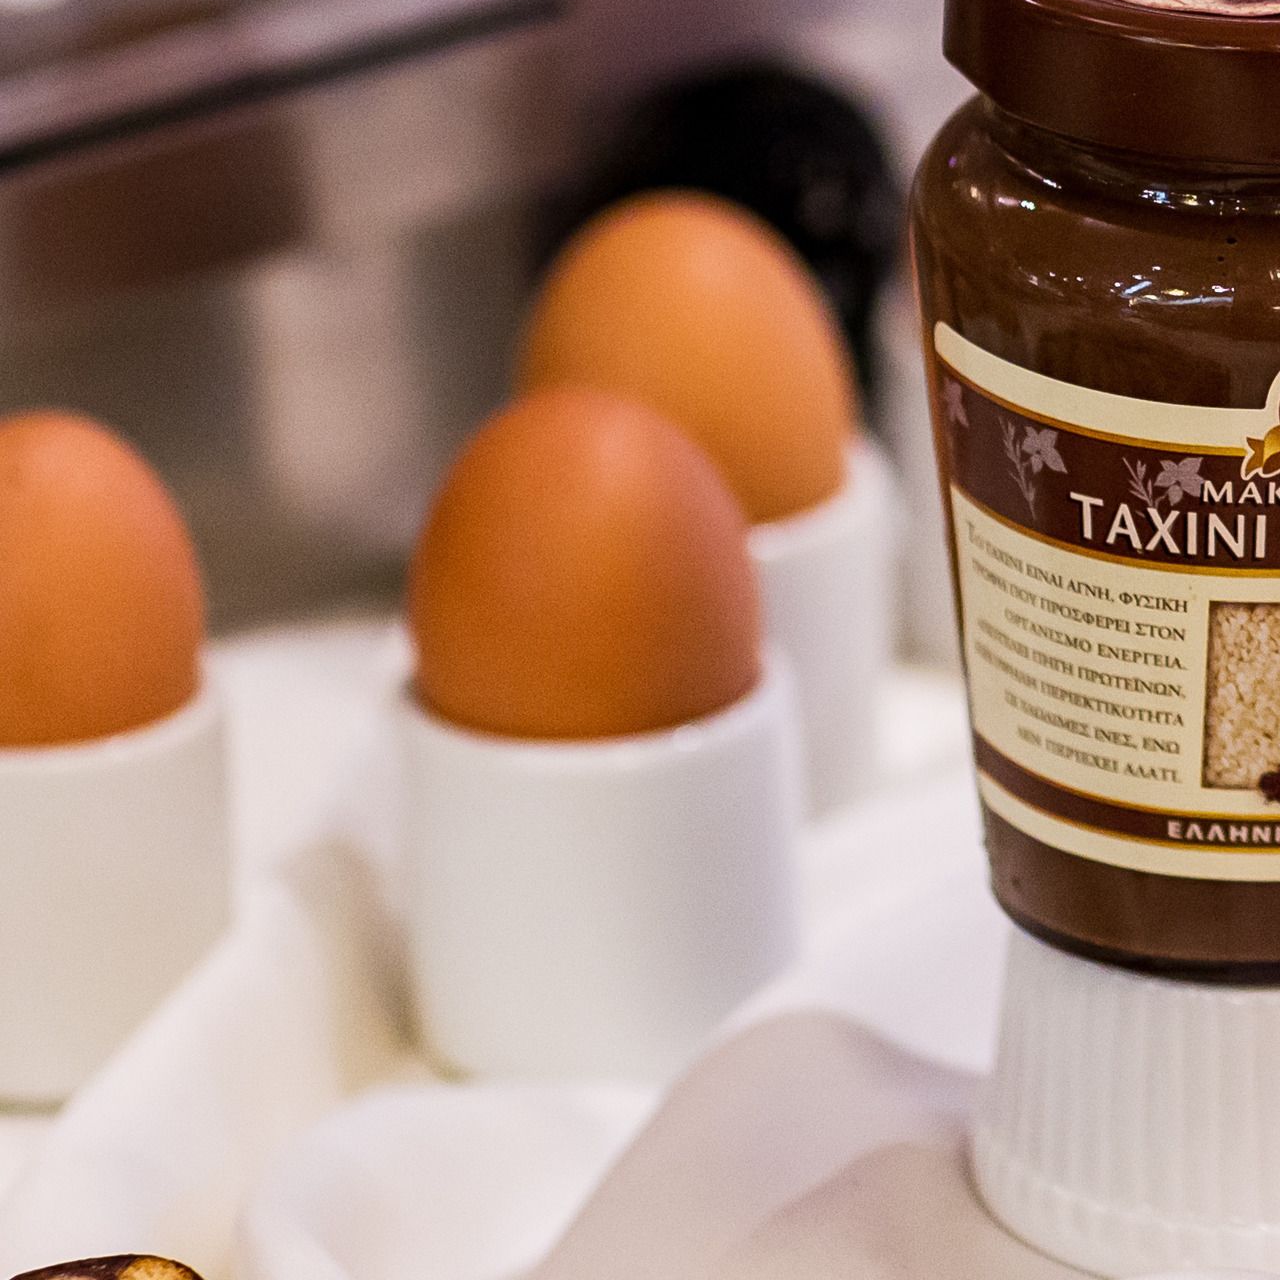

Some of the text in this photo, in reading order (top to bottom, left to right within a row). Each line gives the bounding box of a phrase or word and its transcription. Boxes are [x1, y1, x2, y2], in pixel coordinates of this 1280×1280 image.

[1069, 491, 1268, 560] ΤΑΧΙΝΙ
[1026, 563, 1064, 589] ΕΙΝΑΙ
[1118, 591, 1188, 614] ΦΥΣΙΚΗ
[1004, 607, 1093, 653] ΟΡΓΑΝΙΣΜΟ
[1009, 582, 1038, 607] ΠΟΥ
[1040, 597, 1131, 634] ΠΡΟΣΦΕΡΕΙ
[1134, 621, 1186, 642] ΣΤΟΝ
[1040, 681, 1185, 727] ΠΕΡΙΕΚΤΙΚΟΤΗΤΑ
[1045, 738, 1119, 774] ΠΕΡΙΕΧΕΙ
[1142, 736, 1181, 755] ΕΝΩ
